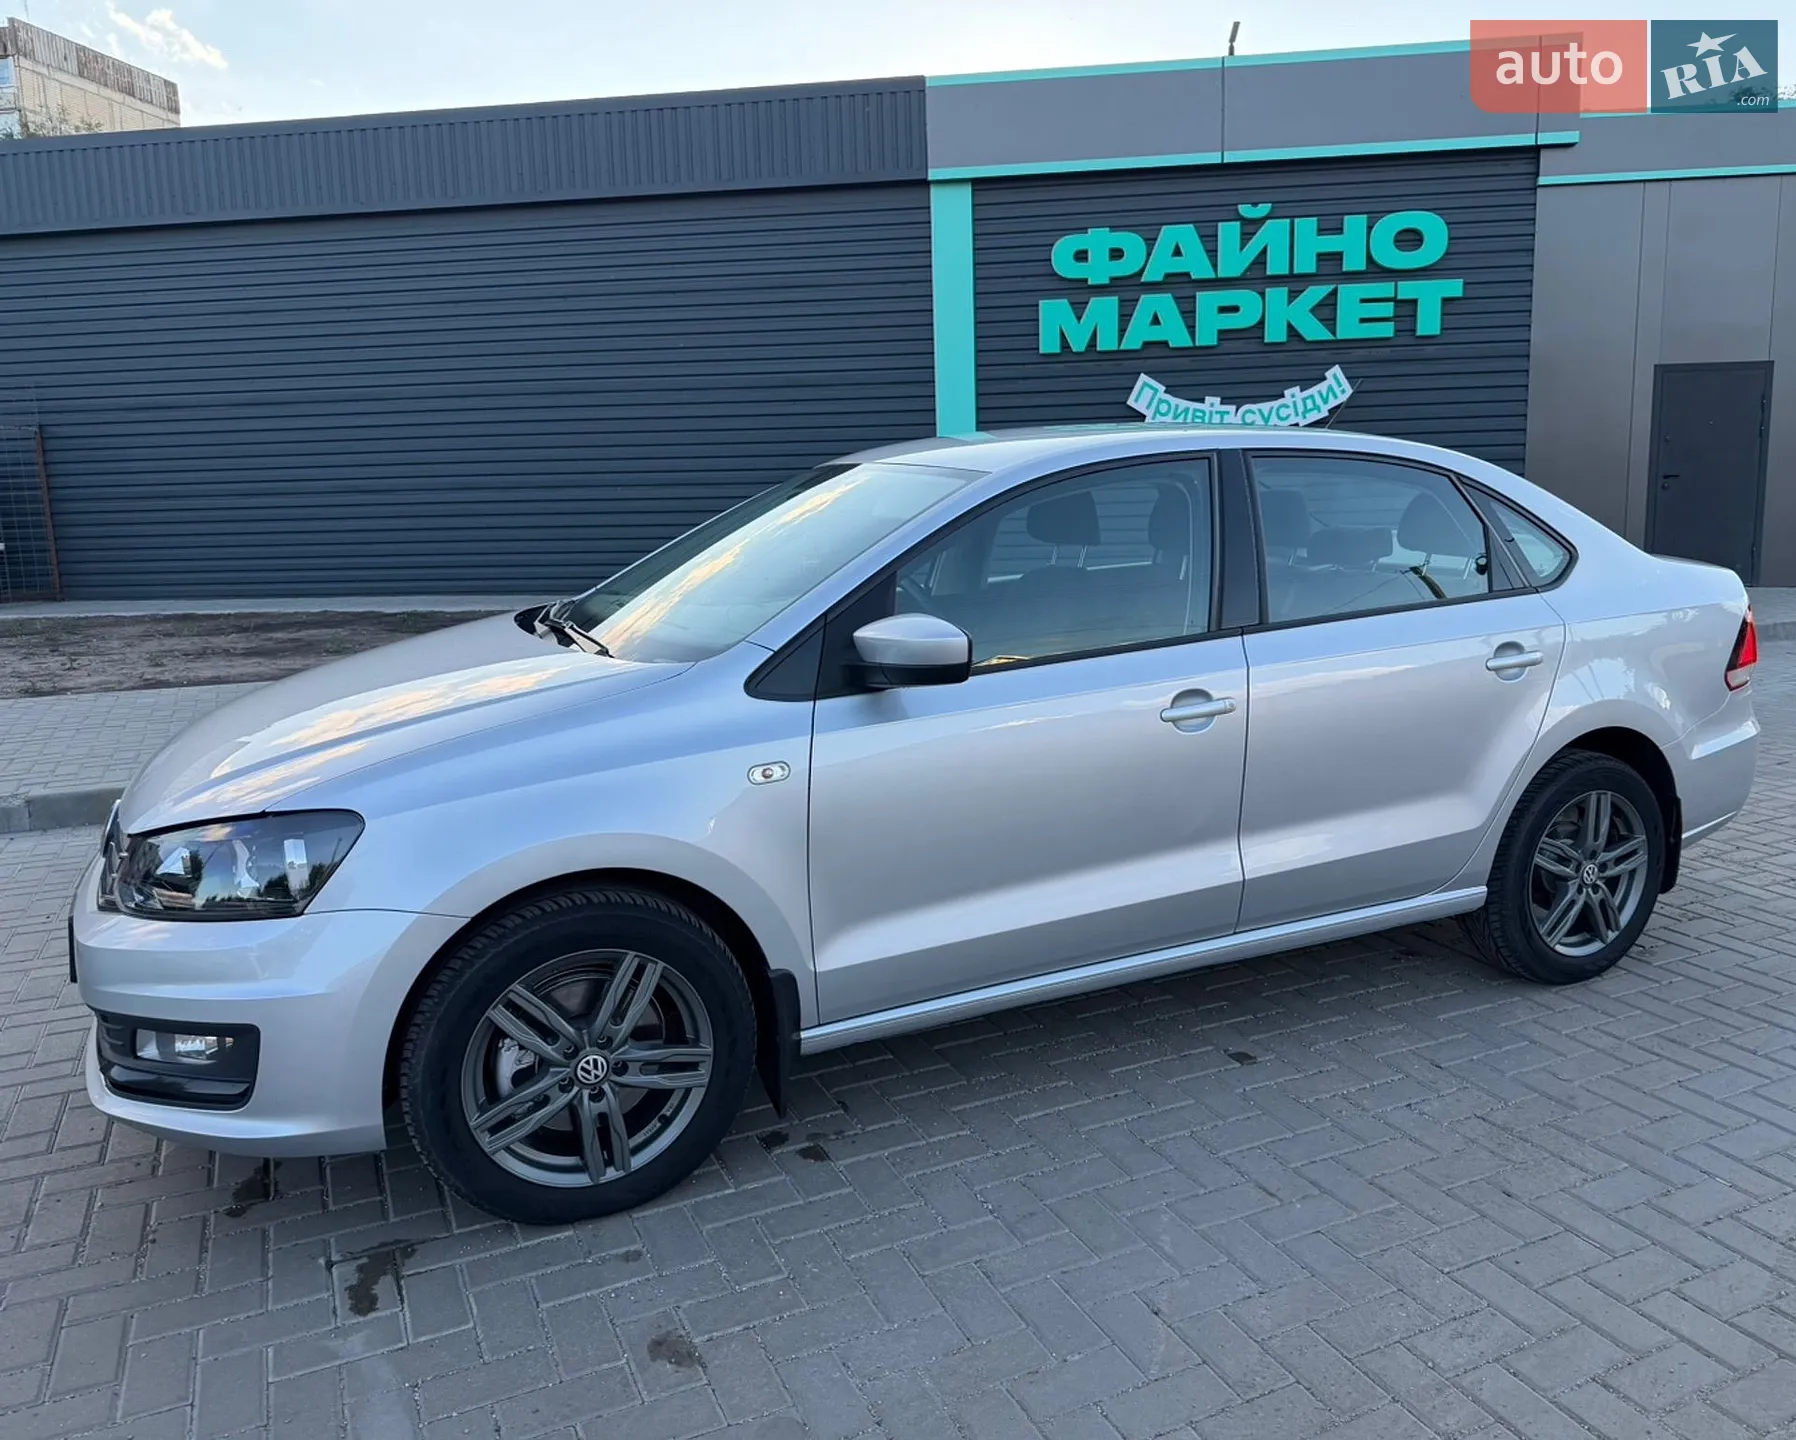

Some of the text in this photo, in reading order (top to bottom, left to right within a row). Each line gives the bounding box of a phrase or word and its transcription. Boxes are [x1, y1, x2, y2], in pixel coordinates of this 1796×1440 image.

[1050, 203, 1449, 286] ФАЙНО
[1038, 278, 1465, 354] МАРКЕТ
[1134, 372, 1347, 426] Привіт сусіди!
